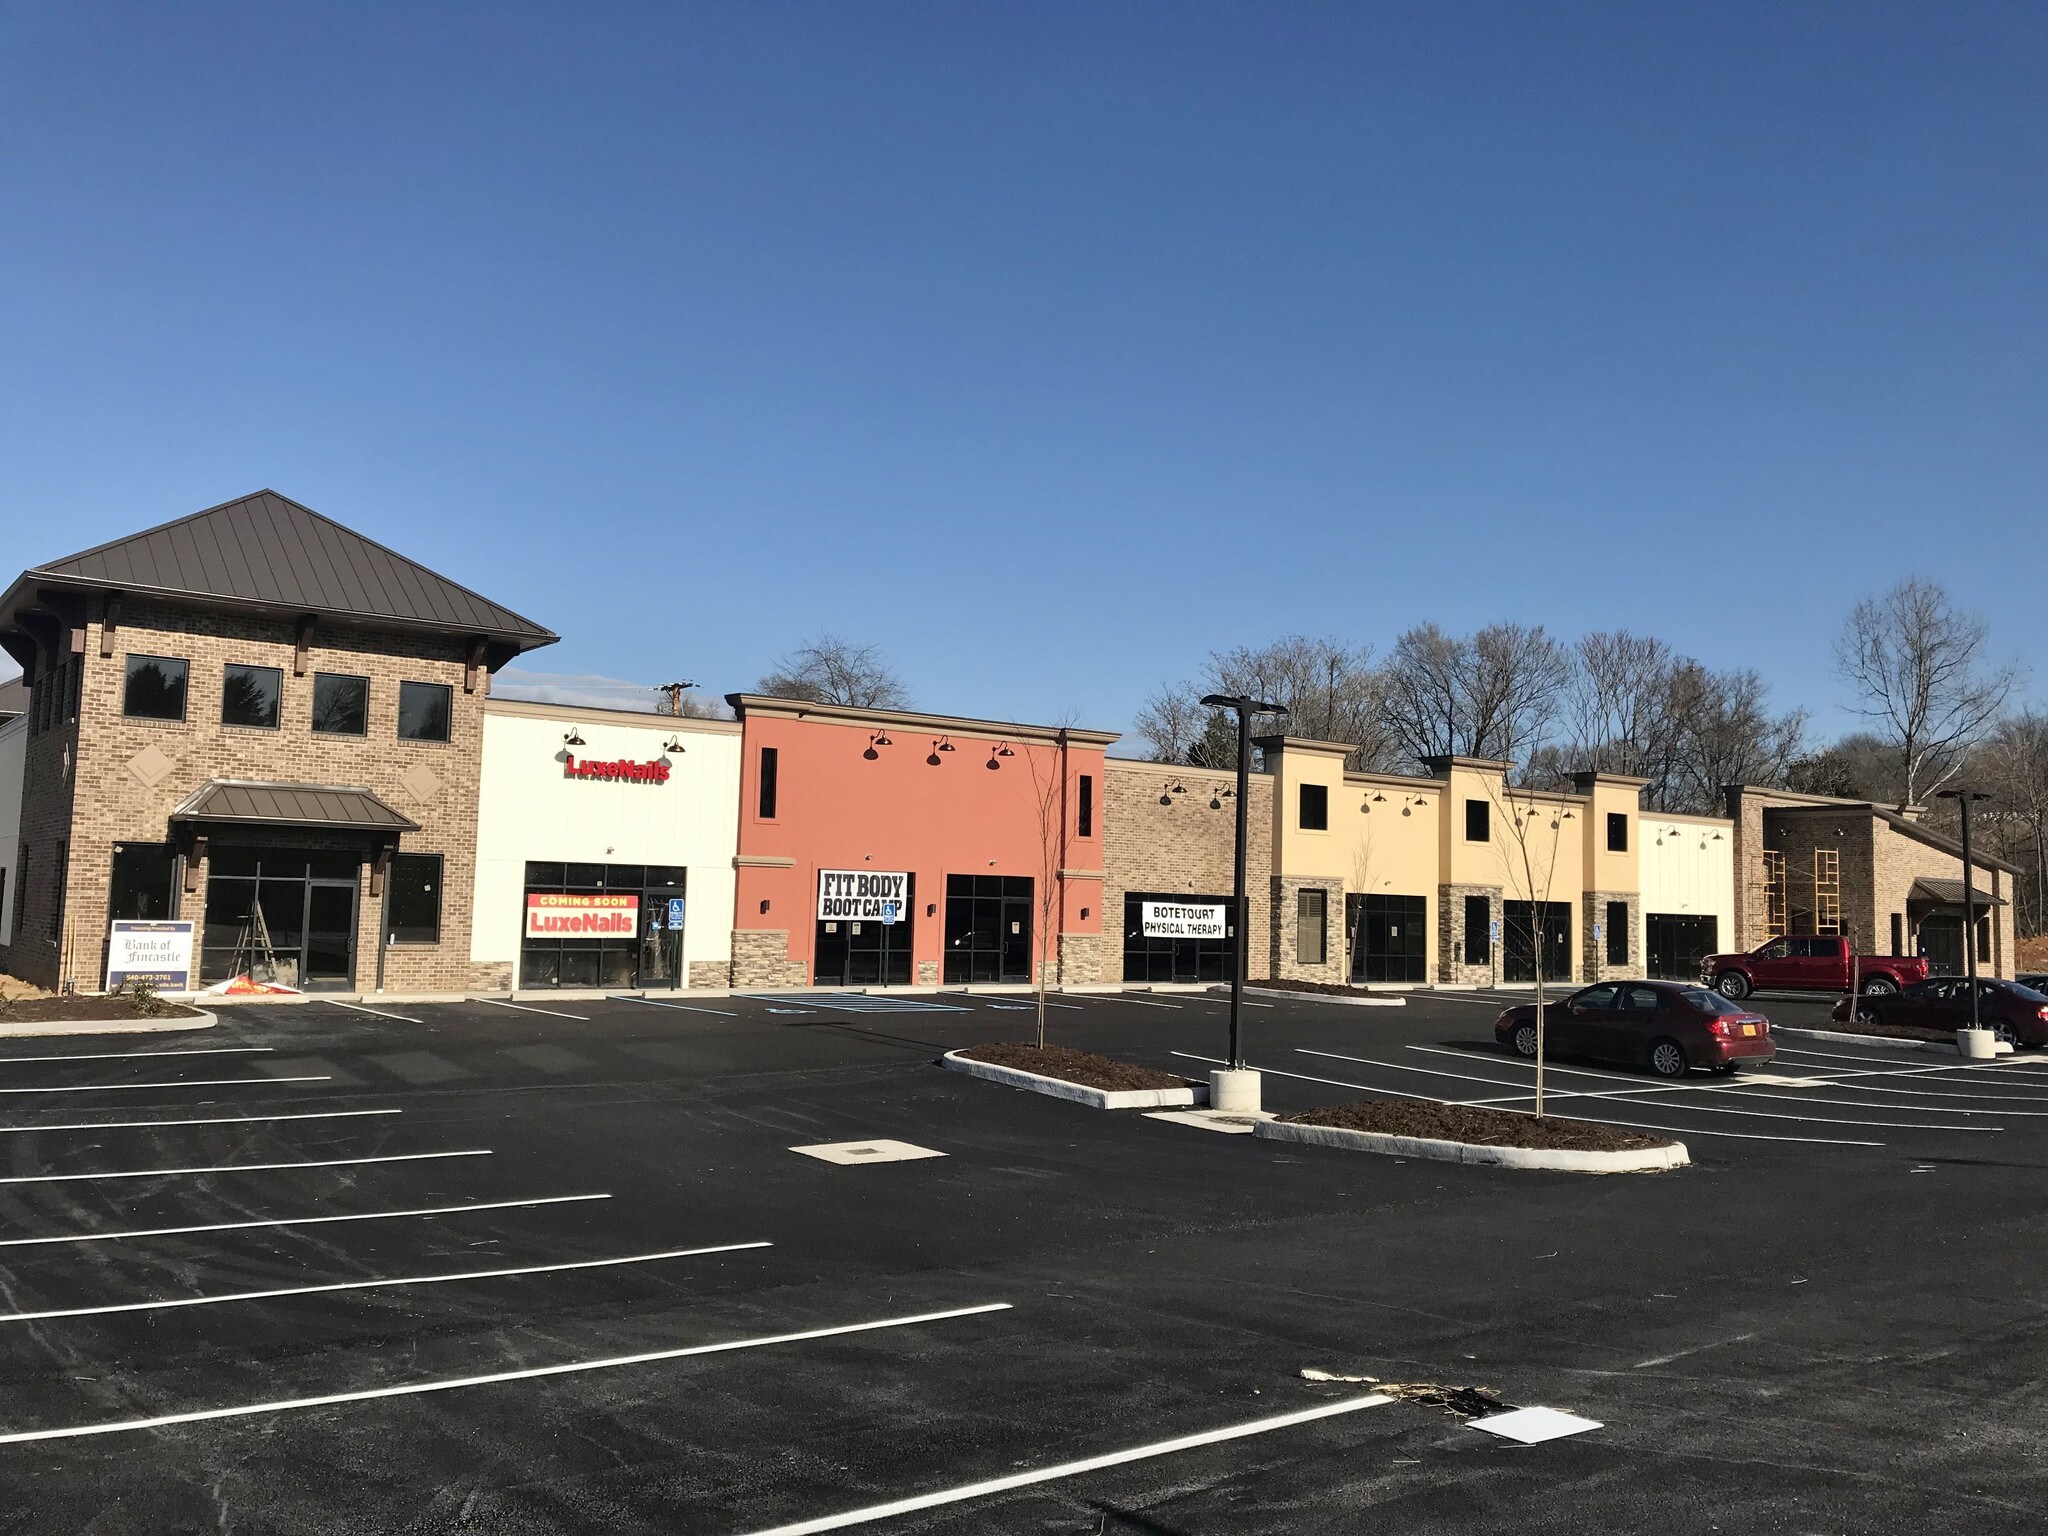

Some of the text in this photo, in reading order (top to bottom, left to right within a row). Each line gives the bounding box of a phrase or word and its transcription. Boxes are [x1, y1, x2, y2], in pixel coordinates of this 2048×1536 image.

[567, 756, 670, 781] LuxeNails
[823, 873, 904, 898] FIT BODY
[540, 897, 628, 907] COMING SOON
[822, 898, 861, 917] BOOT
[1153, 906, 1215, 920] BOTETOURT
[530, 912, 633, 933] LuxeNails
[1144, 921, 1223, 935] PHYSICAL THERAPY
[124, 939, 172, 950] Bank of
[124, 951, 181, 964] Fincastle
